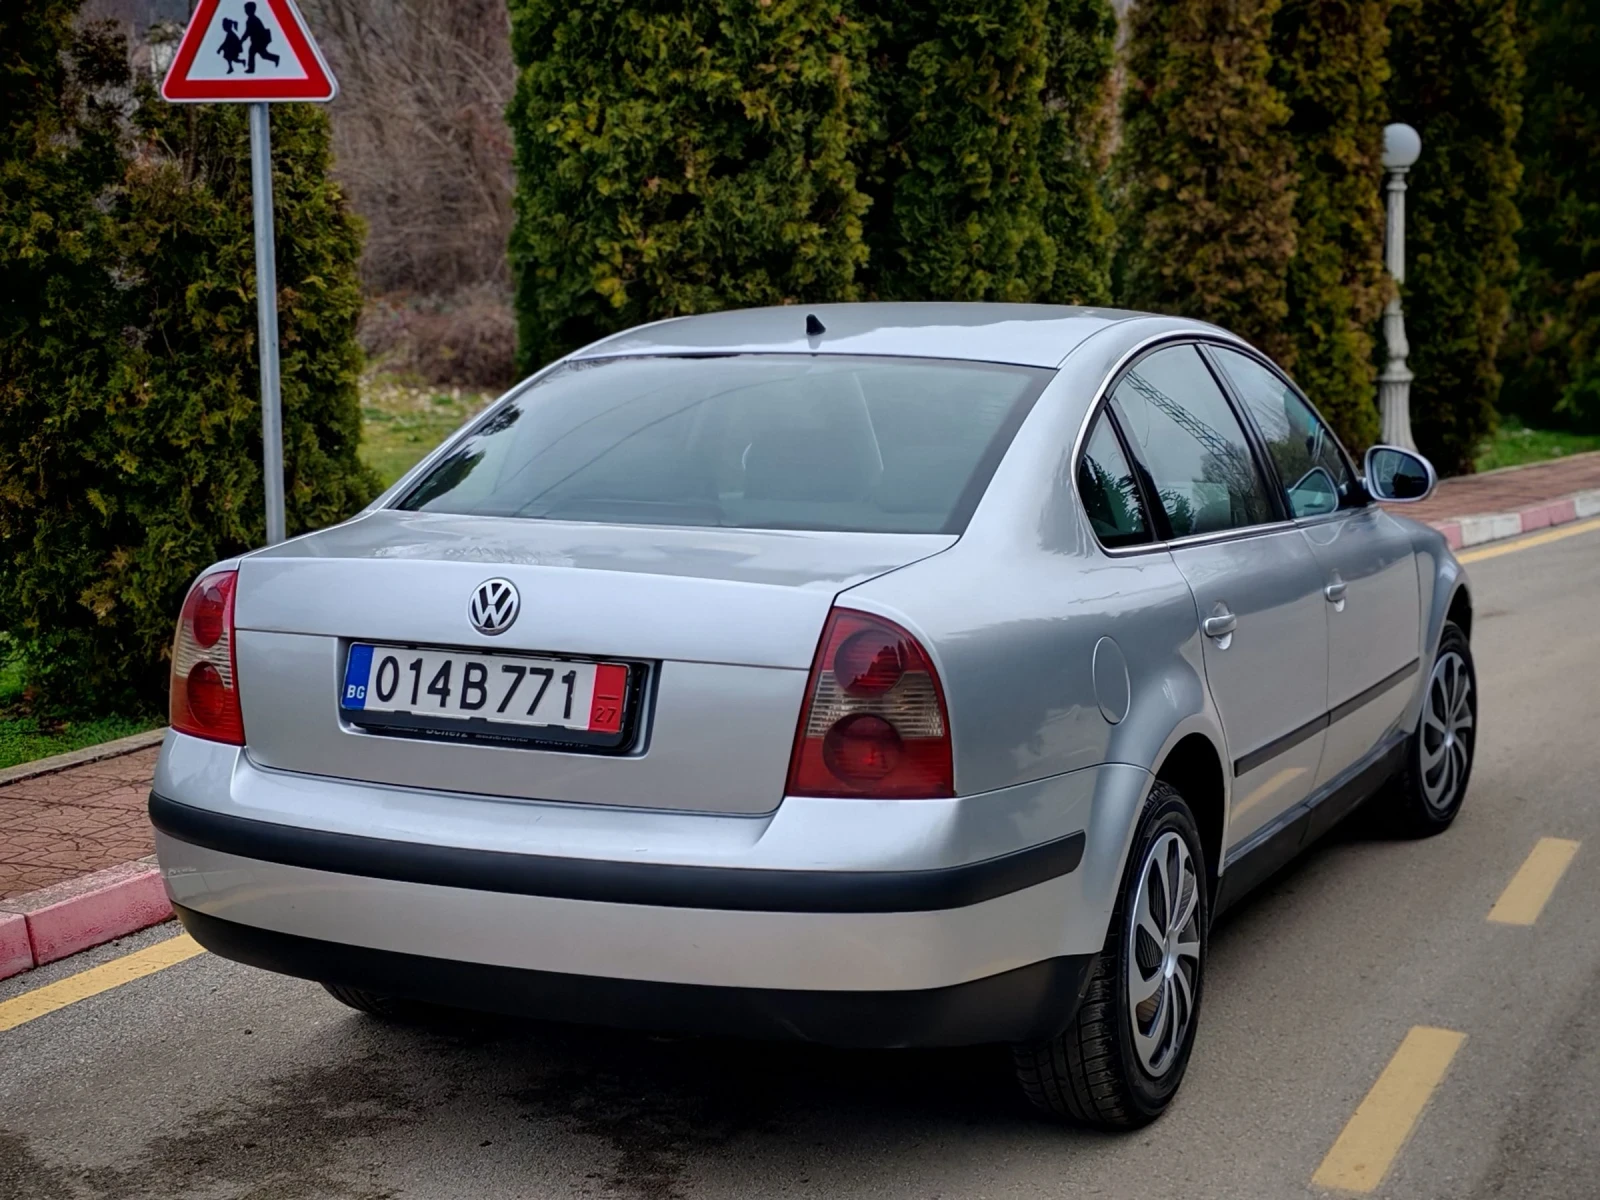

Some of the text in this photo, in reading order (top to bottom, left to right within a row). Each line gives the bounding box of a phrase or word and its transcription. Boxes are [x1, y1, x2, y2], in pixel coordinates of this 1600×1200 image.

[469, 578, 519, 633] VW
[346, 684, 366, 699] BG
[375, 655, 577, 720] 014B771
[594, 706, 617, 723] 27
